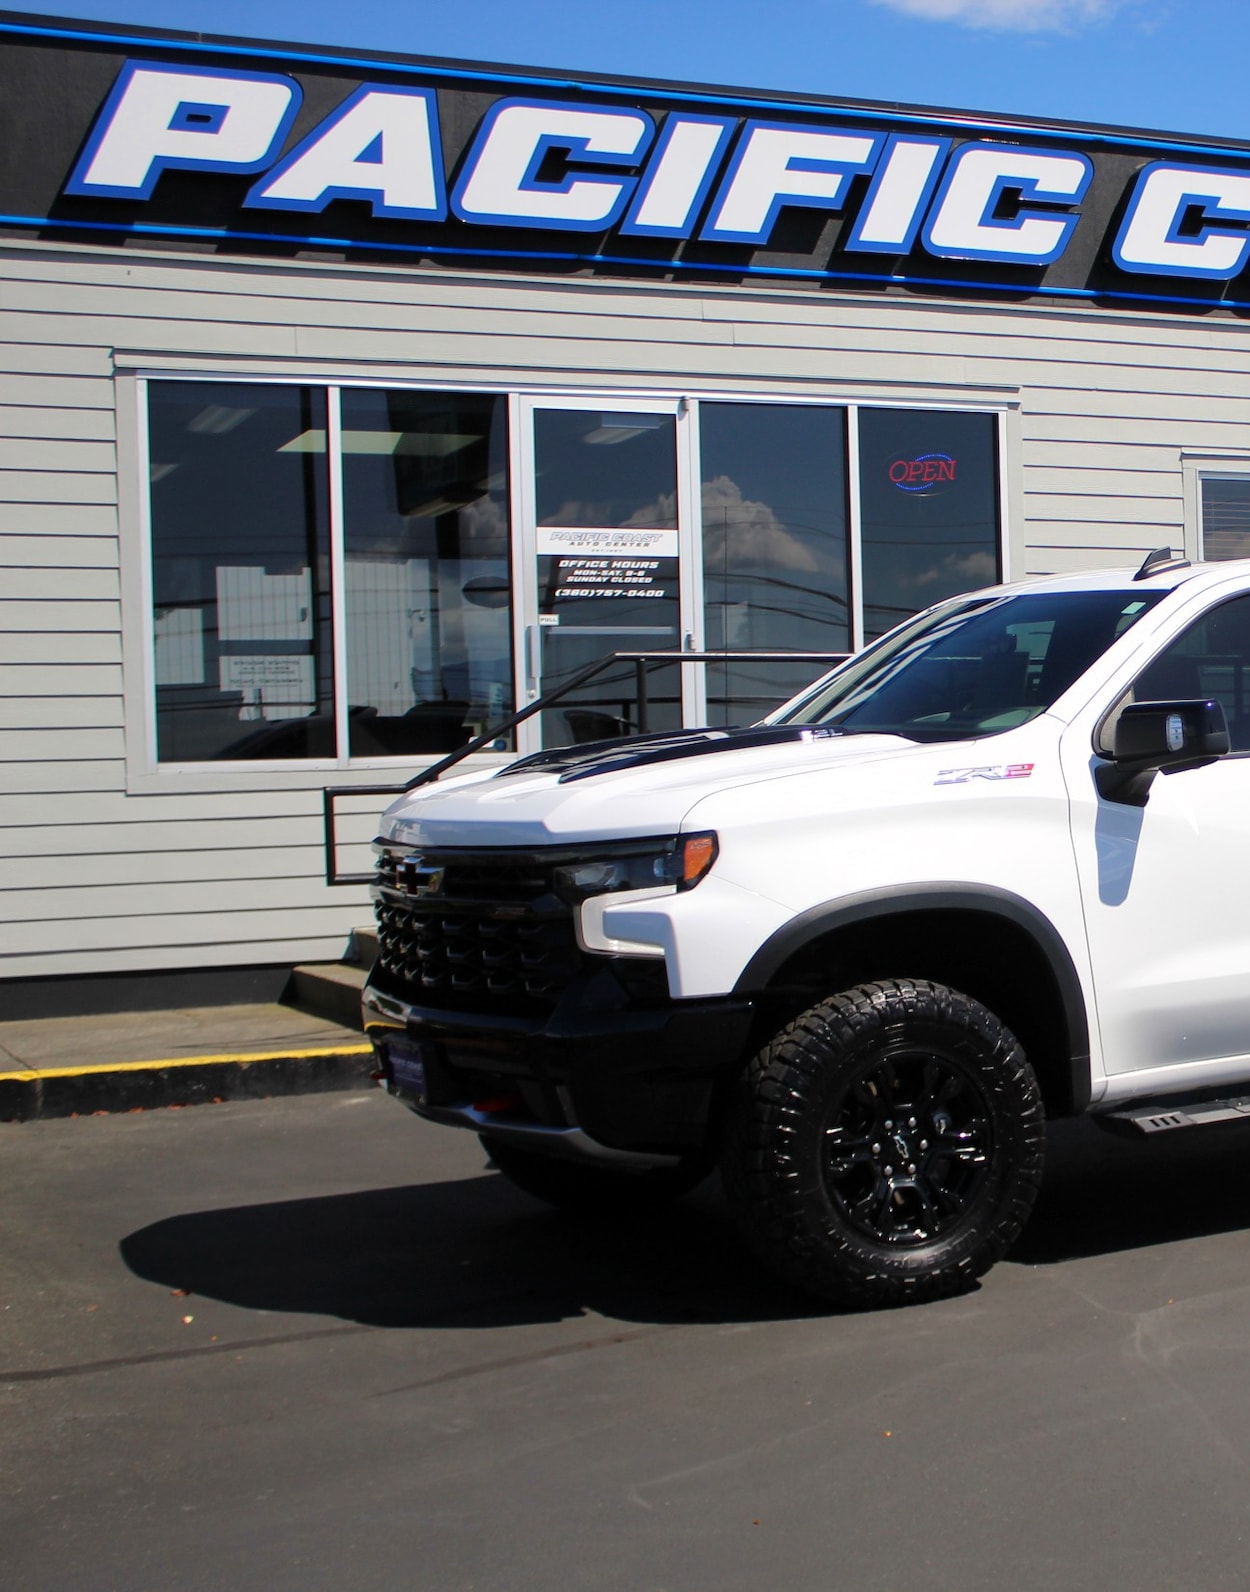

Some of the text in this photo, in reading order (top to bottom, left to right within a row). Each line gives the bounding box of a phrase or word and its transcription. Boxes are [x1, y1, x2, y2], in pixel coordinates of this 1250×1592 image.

[72, 62, 1091, 261] PACIFIC
[888, 459, 957, 483] OPEN
[550, 531, 663, 543] PACIFIC COAST
[558, 559, 659, 569] OFFICE HOURS
[611, 576, 653, 584] CLOSED
[933, 763, 1035, 786] ZR2
